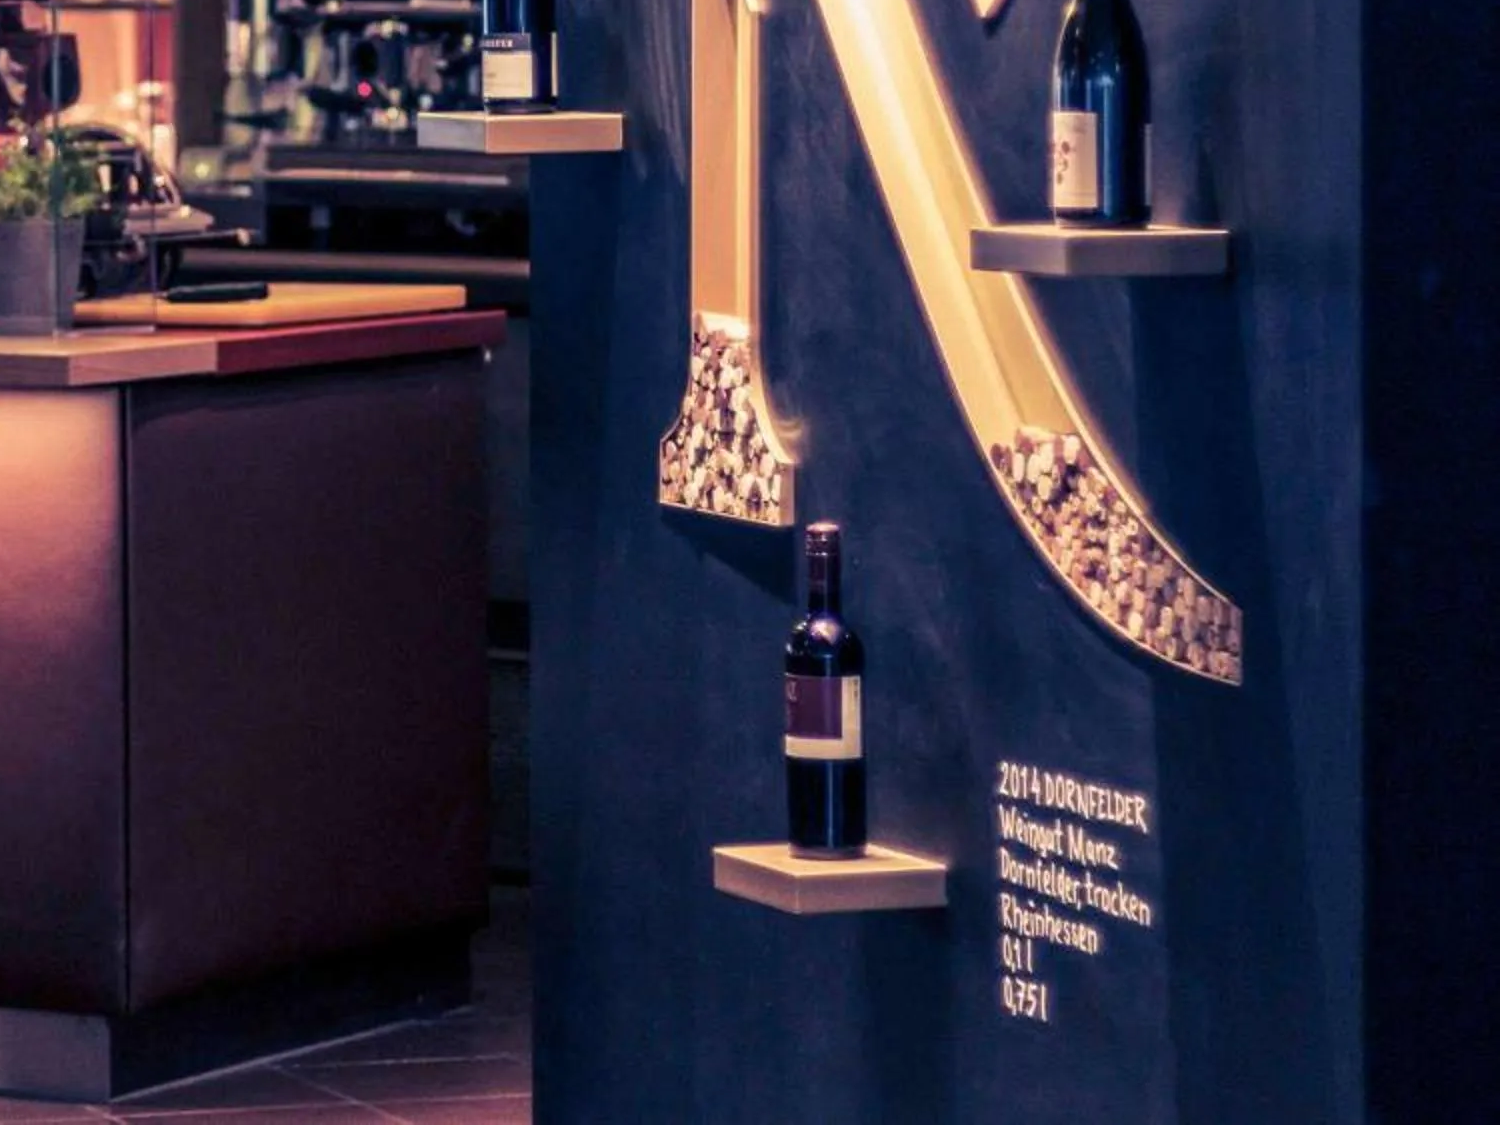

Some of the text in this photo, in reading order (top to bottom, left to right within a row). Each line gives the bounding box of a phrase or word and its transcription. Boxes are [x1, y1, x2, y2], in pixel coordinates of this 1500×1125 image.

[999, 762, 1148, 833] 2014 DORNFELDER
[999, 804, 1119, 870] Weingut Manz
[1000, 892, 1099, 955] Rheinhessen
[1084, 872, 1151, 926] trocken
